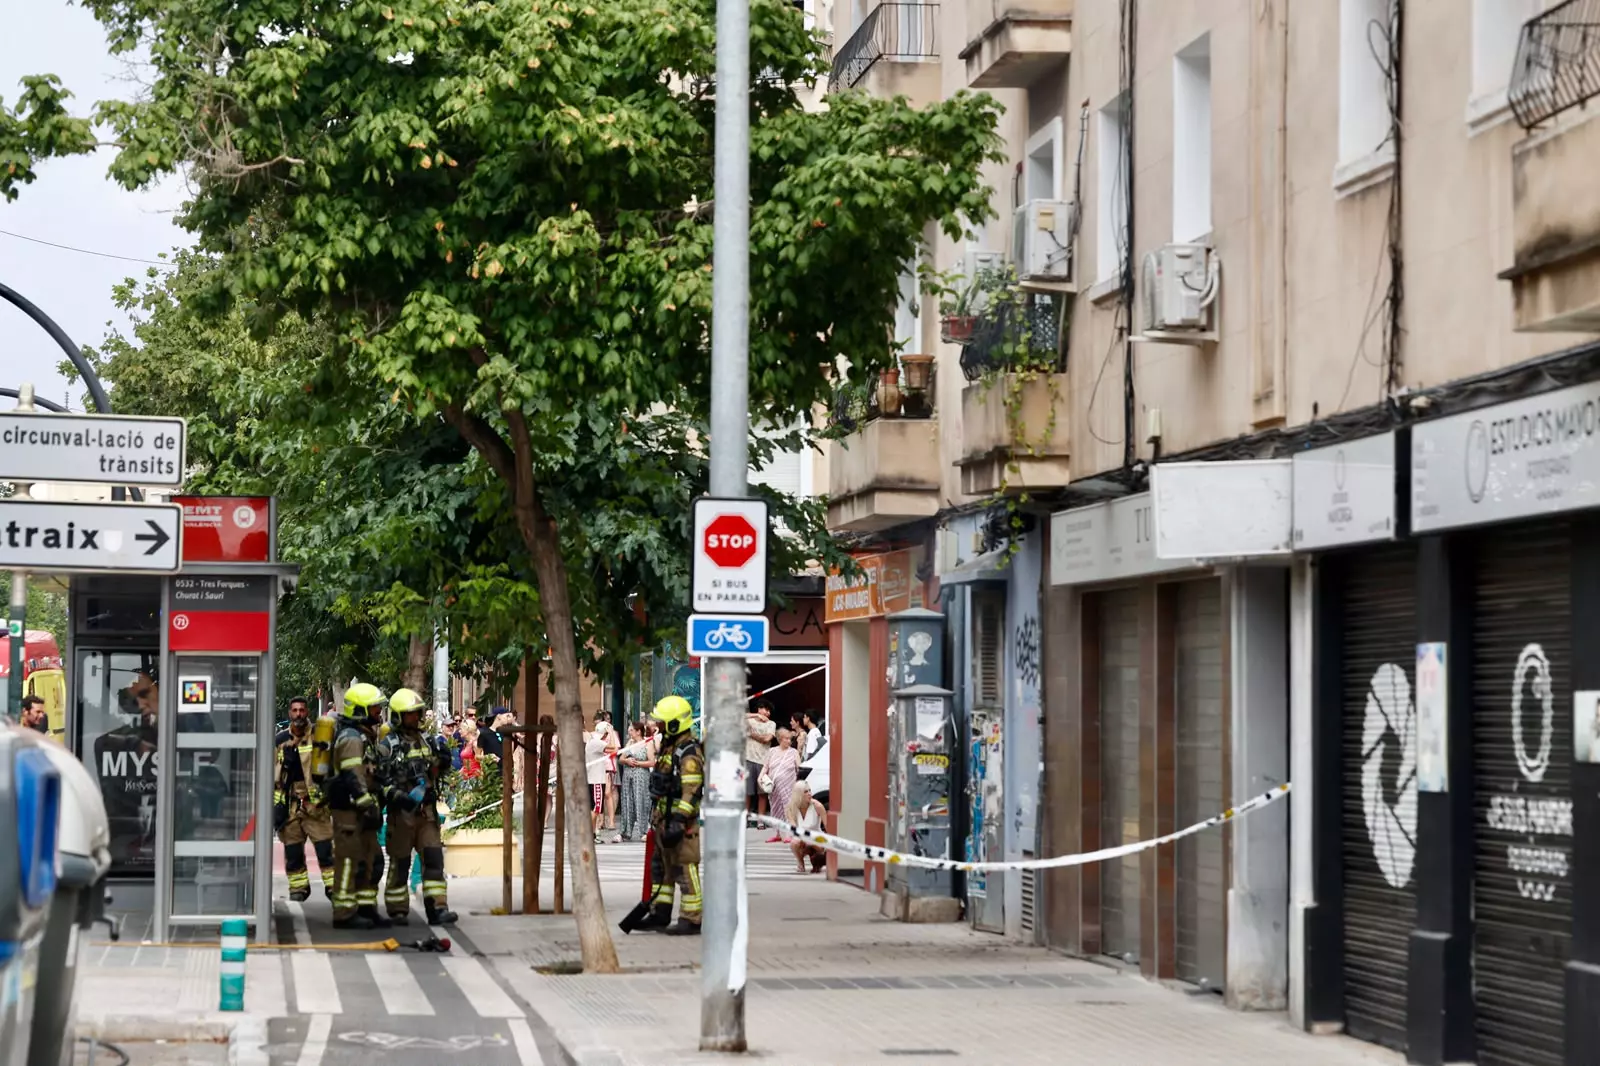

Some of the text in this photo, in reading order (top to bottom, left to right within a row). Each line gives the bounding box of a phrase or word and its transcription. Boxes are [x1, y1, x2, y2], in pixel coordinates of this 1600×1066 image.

[1554, 398, 1600, 442] MAYO
[154, 433, 175, 450] de
[99, 454, 174, 474] trànsits
[184, 506, 222, 515] EMT
[0, 521, 99, 550] traix
[708, 534, 753, 548] STOP
[175, 580, 194, 588] 0532
[200, 580, 216, 588] Tres
[217, 580, 245, 590] Forques
[712, 579, 748, 589] SI BUS
[697, 593, 760, 602] EN PARADA
[774, 607, 829, 635] CA
